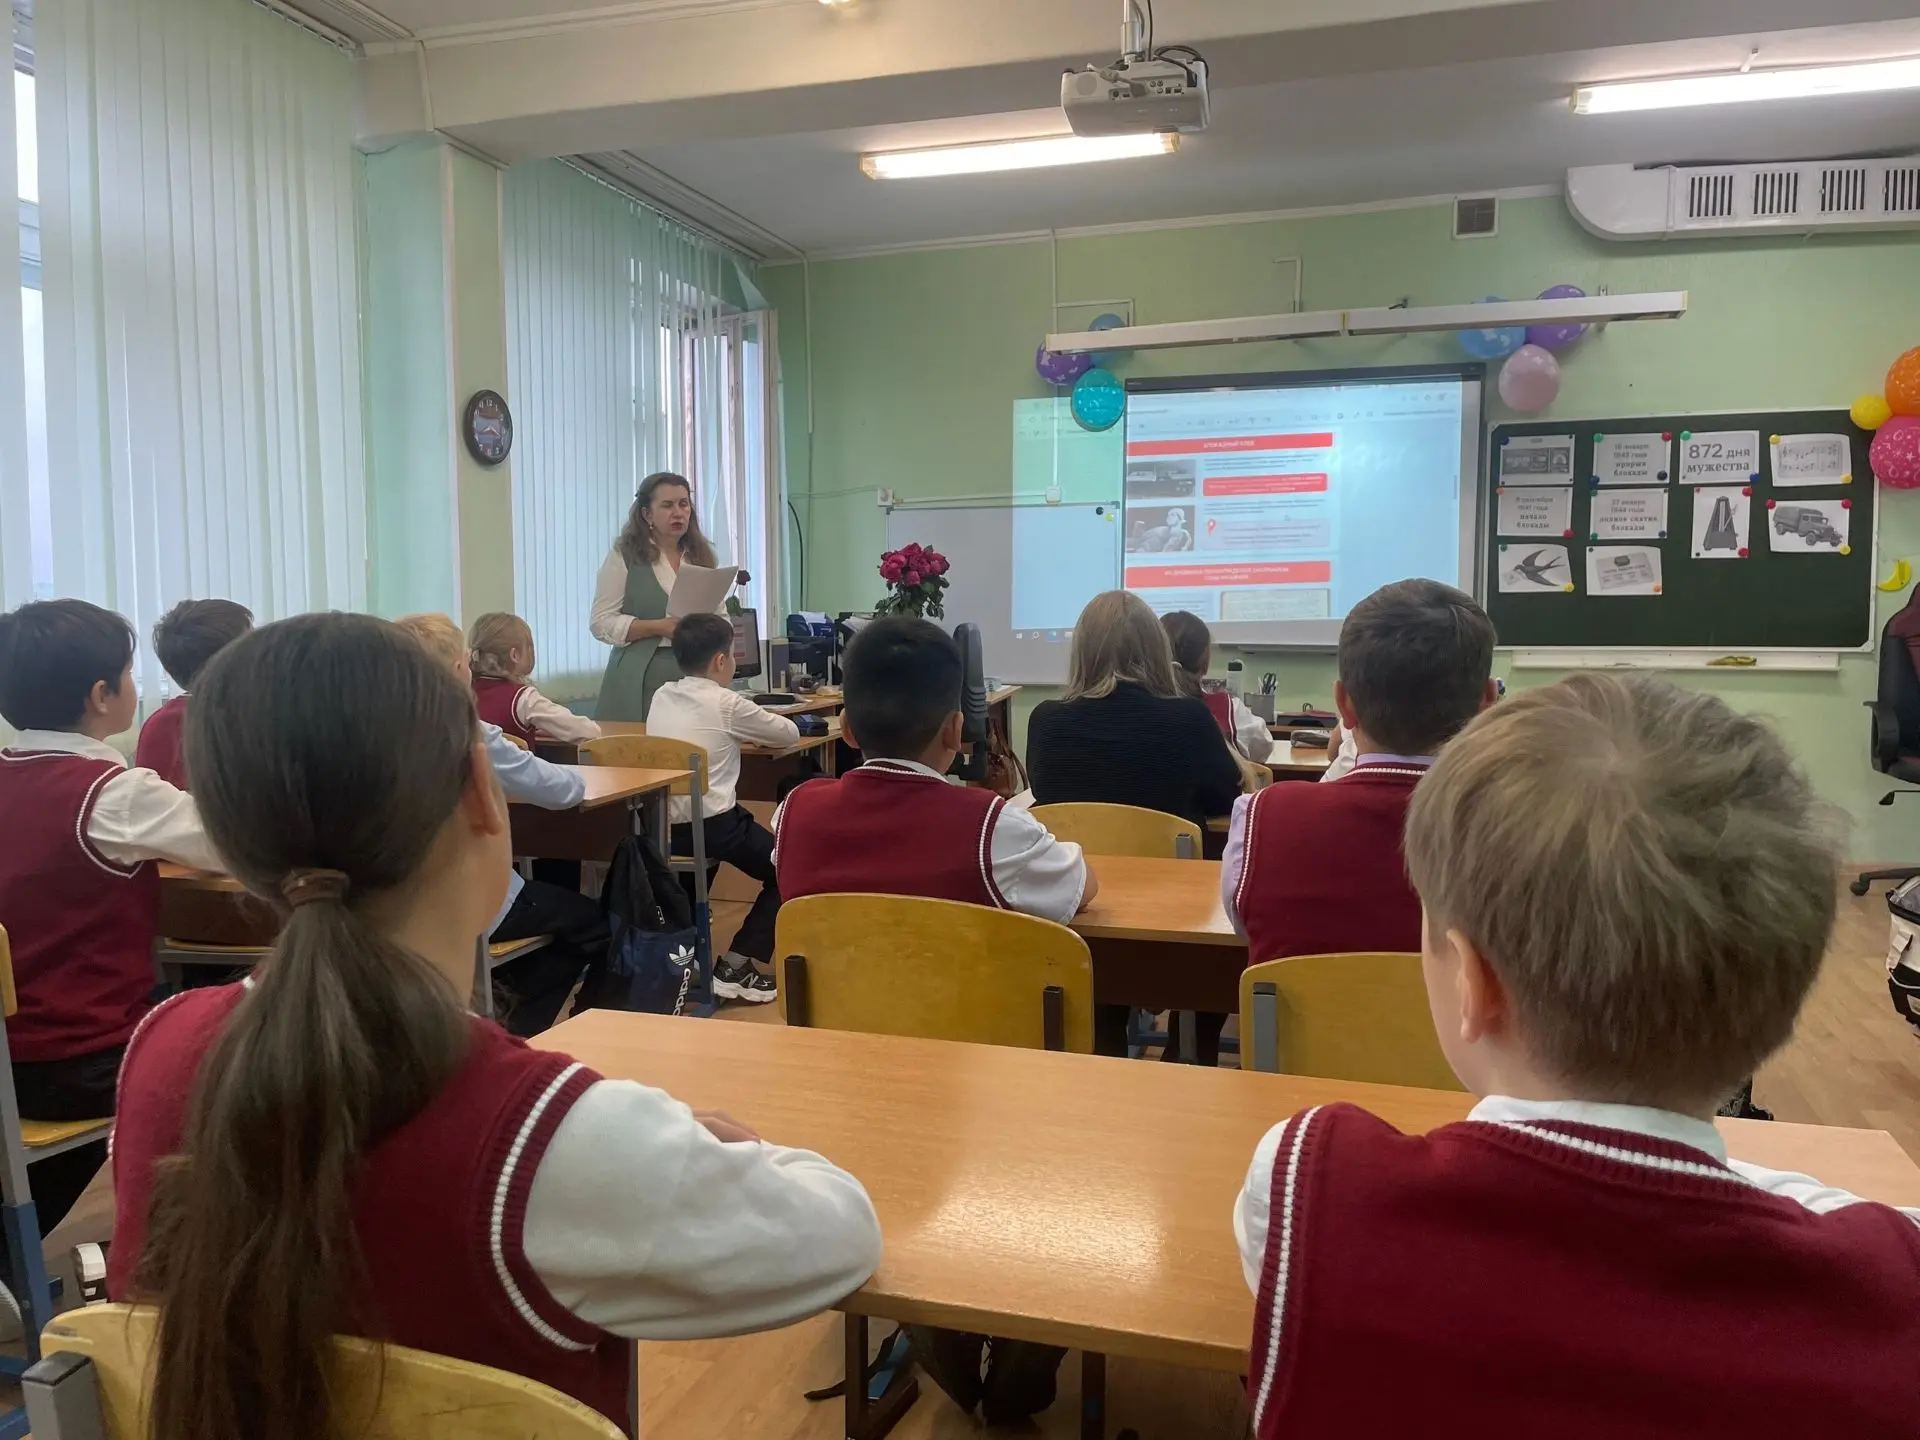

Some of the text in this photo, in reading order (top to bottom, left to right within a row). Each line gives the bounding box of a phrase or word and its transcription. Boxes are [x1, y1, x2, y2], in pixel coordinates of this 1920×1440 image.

[1688, 443, 1750, 459] 872 дня
[1687, 462, 1750, 476] мужества
[673, 968, 691, 1016] adida
